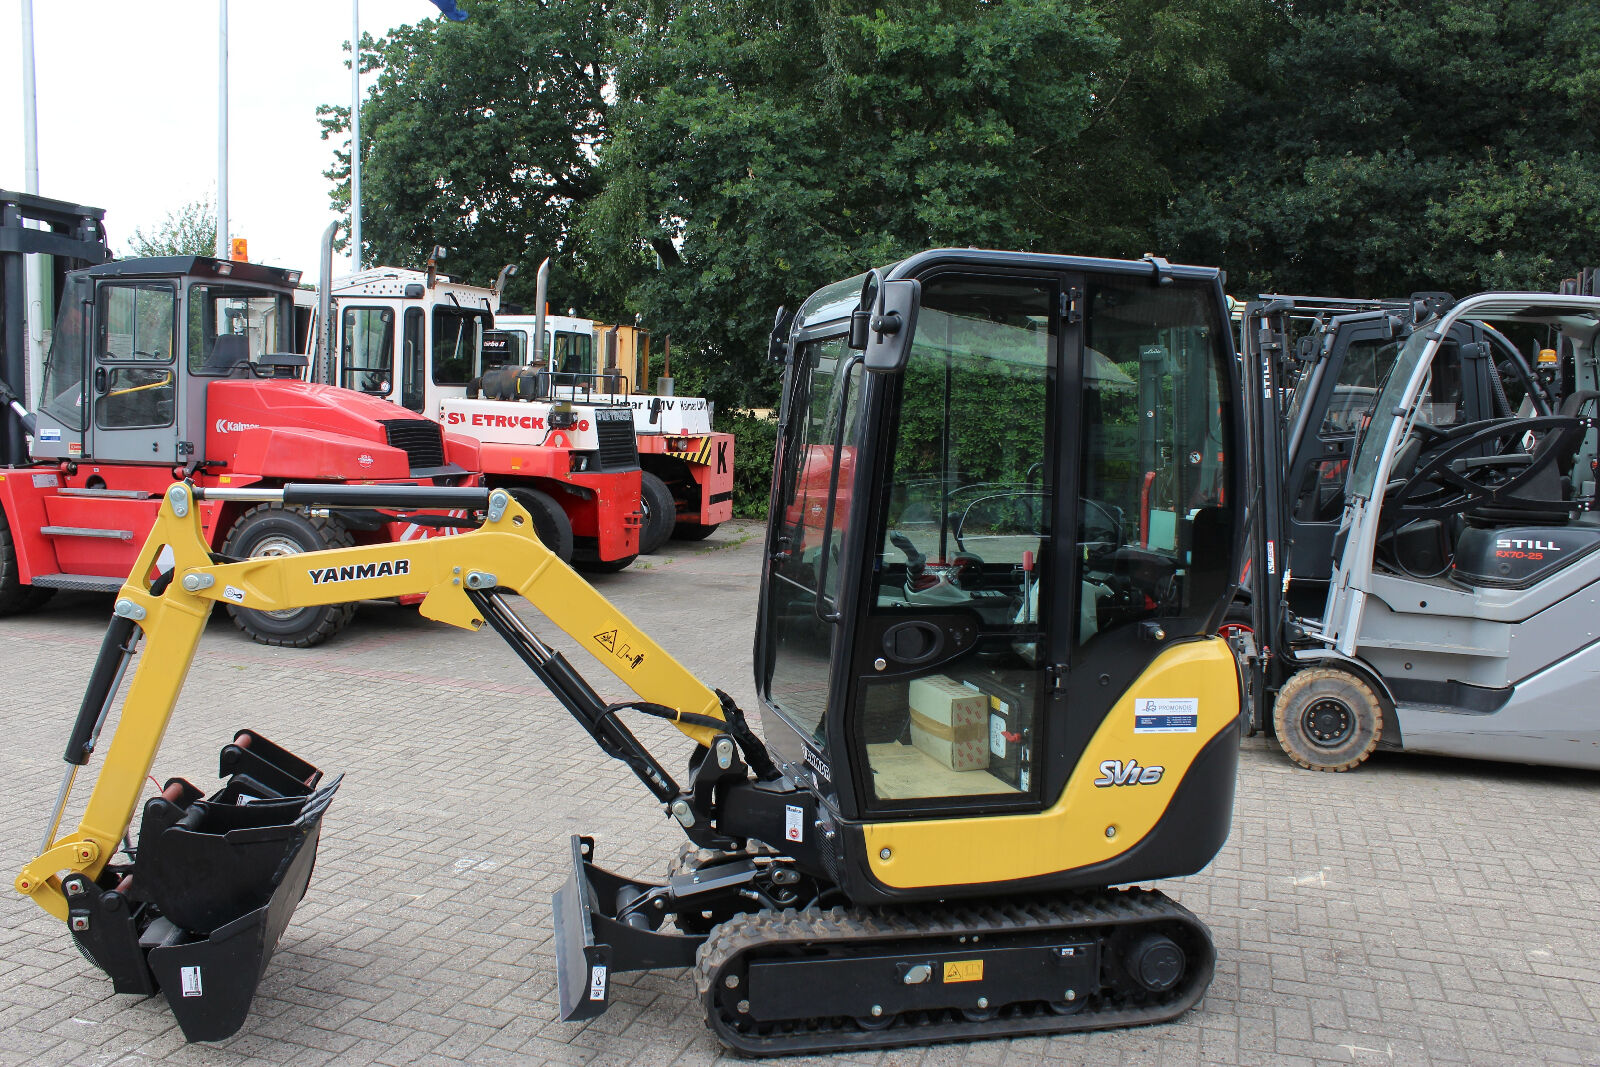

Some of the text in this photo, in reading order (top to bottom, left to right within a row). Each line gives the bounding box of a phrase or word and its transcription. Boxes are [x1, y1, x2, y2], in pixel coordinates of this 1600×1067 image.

[1263, 357, 1271, 399] STILL
[716, 441, 728, 475] K
[1495, 550, 1544, 561] RX70-25
[1496, 539, 1561, 552] STILL
[308, 559, 409, 584] YANMAR
[1094, 758, 1166, 788] SV16
